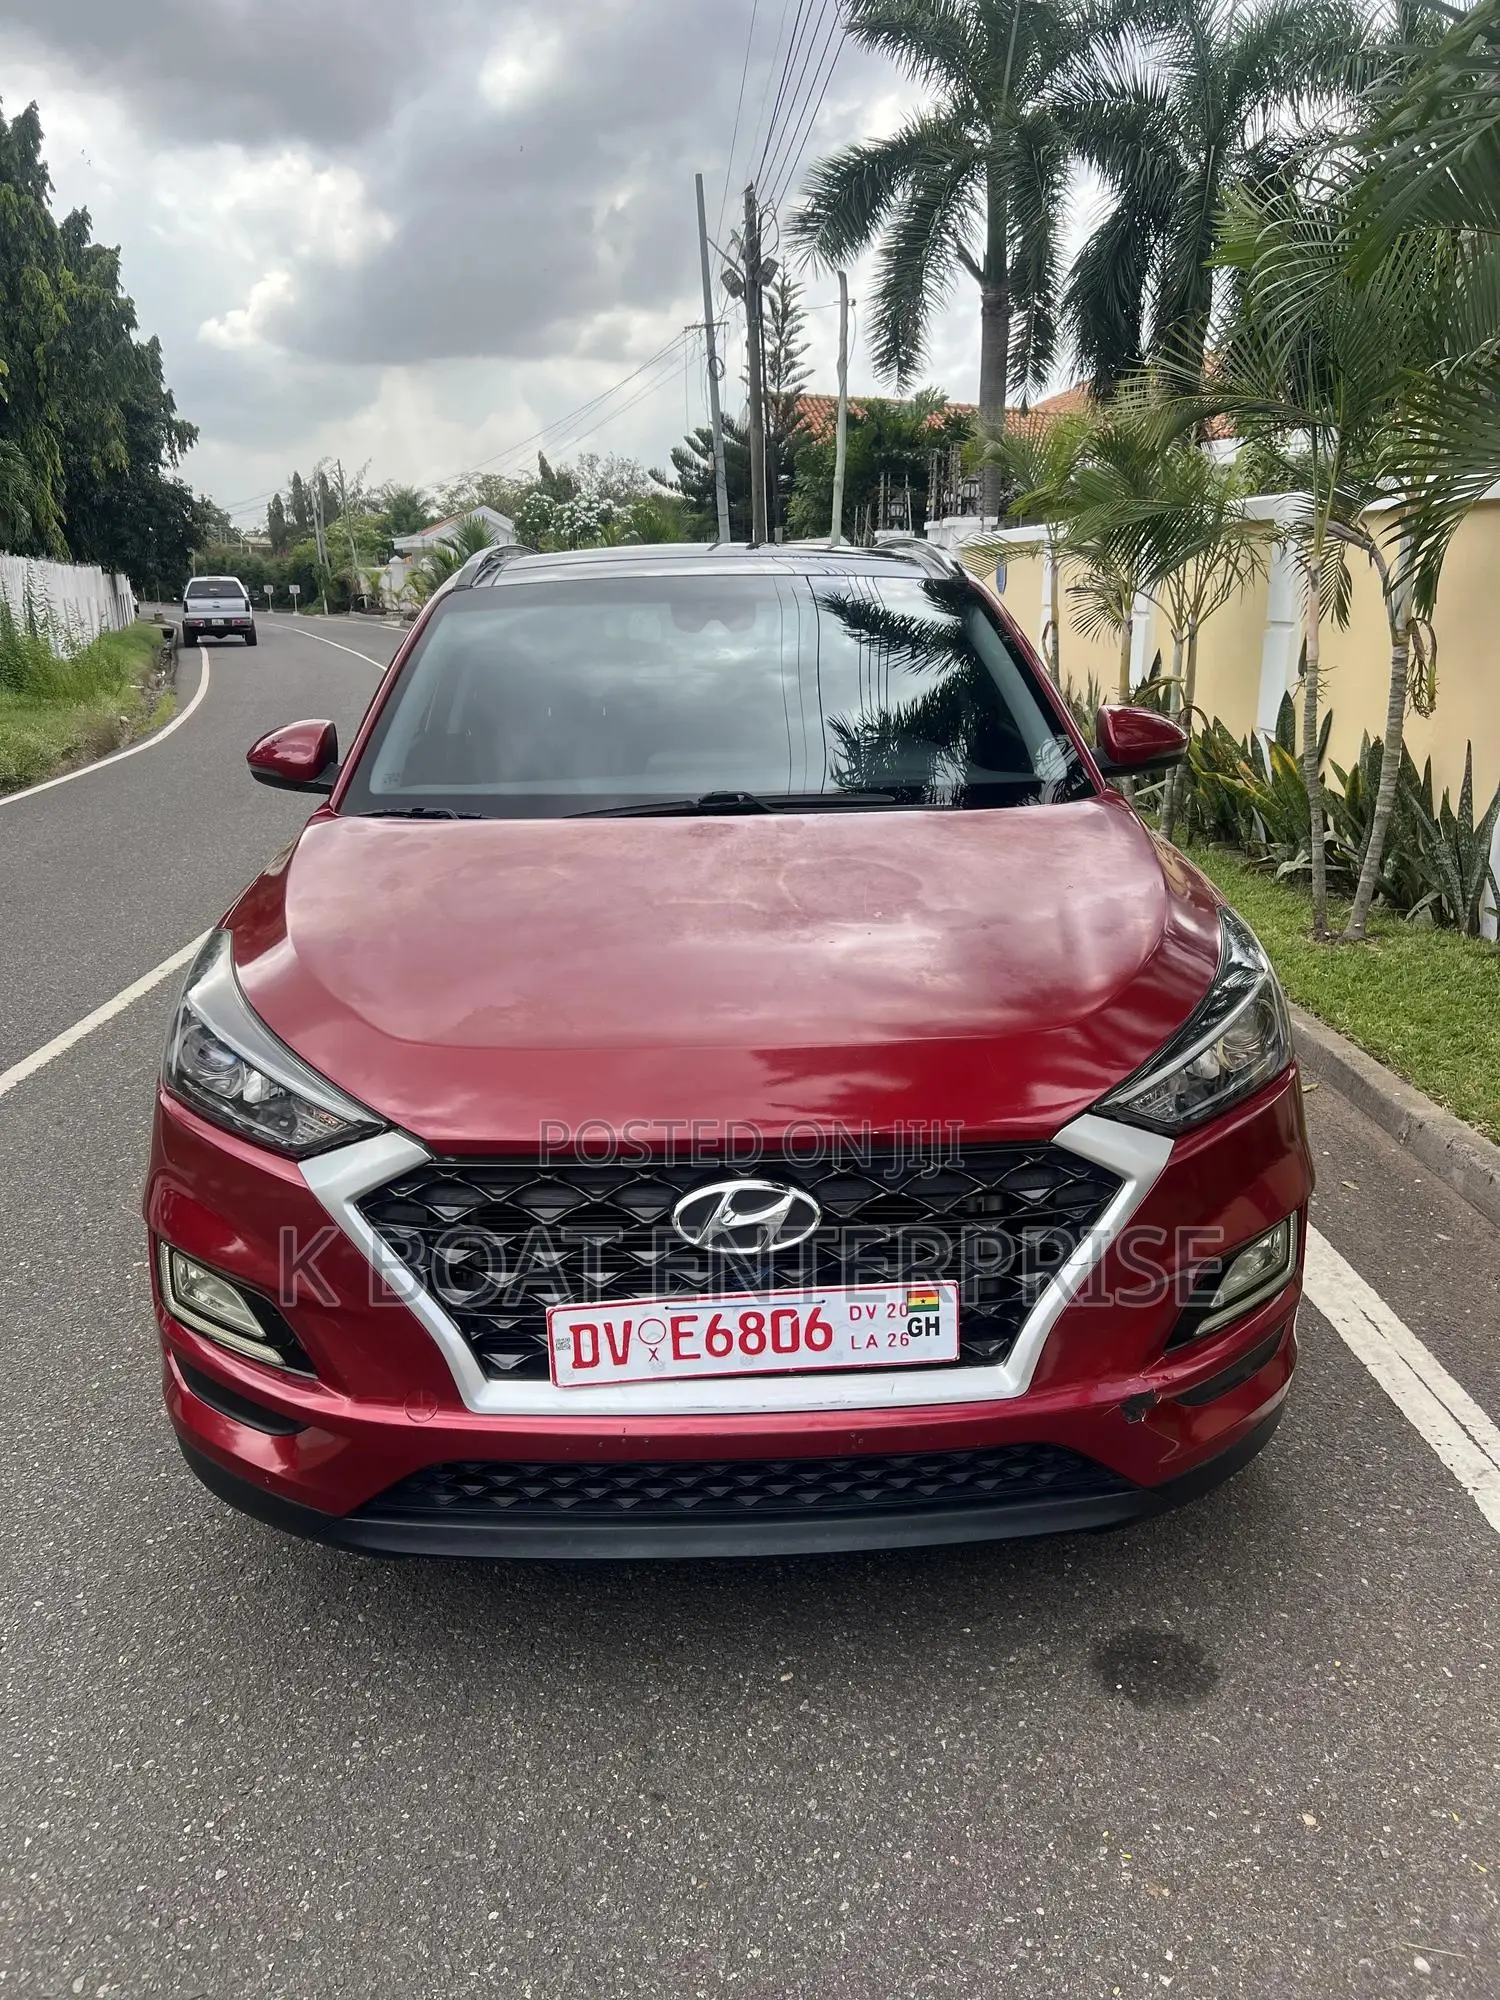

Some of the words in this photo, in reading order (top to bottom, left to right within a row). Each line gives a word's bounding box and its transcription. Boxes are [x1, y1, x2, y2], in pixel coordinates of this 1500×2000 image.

[849, 1304, 877, 1321] DV
[887, 1303, 909, 1318] 20
[907, 1316, 940, 1338] GH
[569, 1320, 633, 1369] DV
[670, 1306, 833, 1360] E6806
[851, 1334, 879, 1350] LA
[887, 1332, 909, 1348] 26
